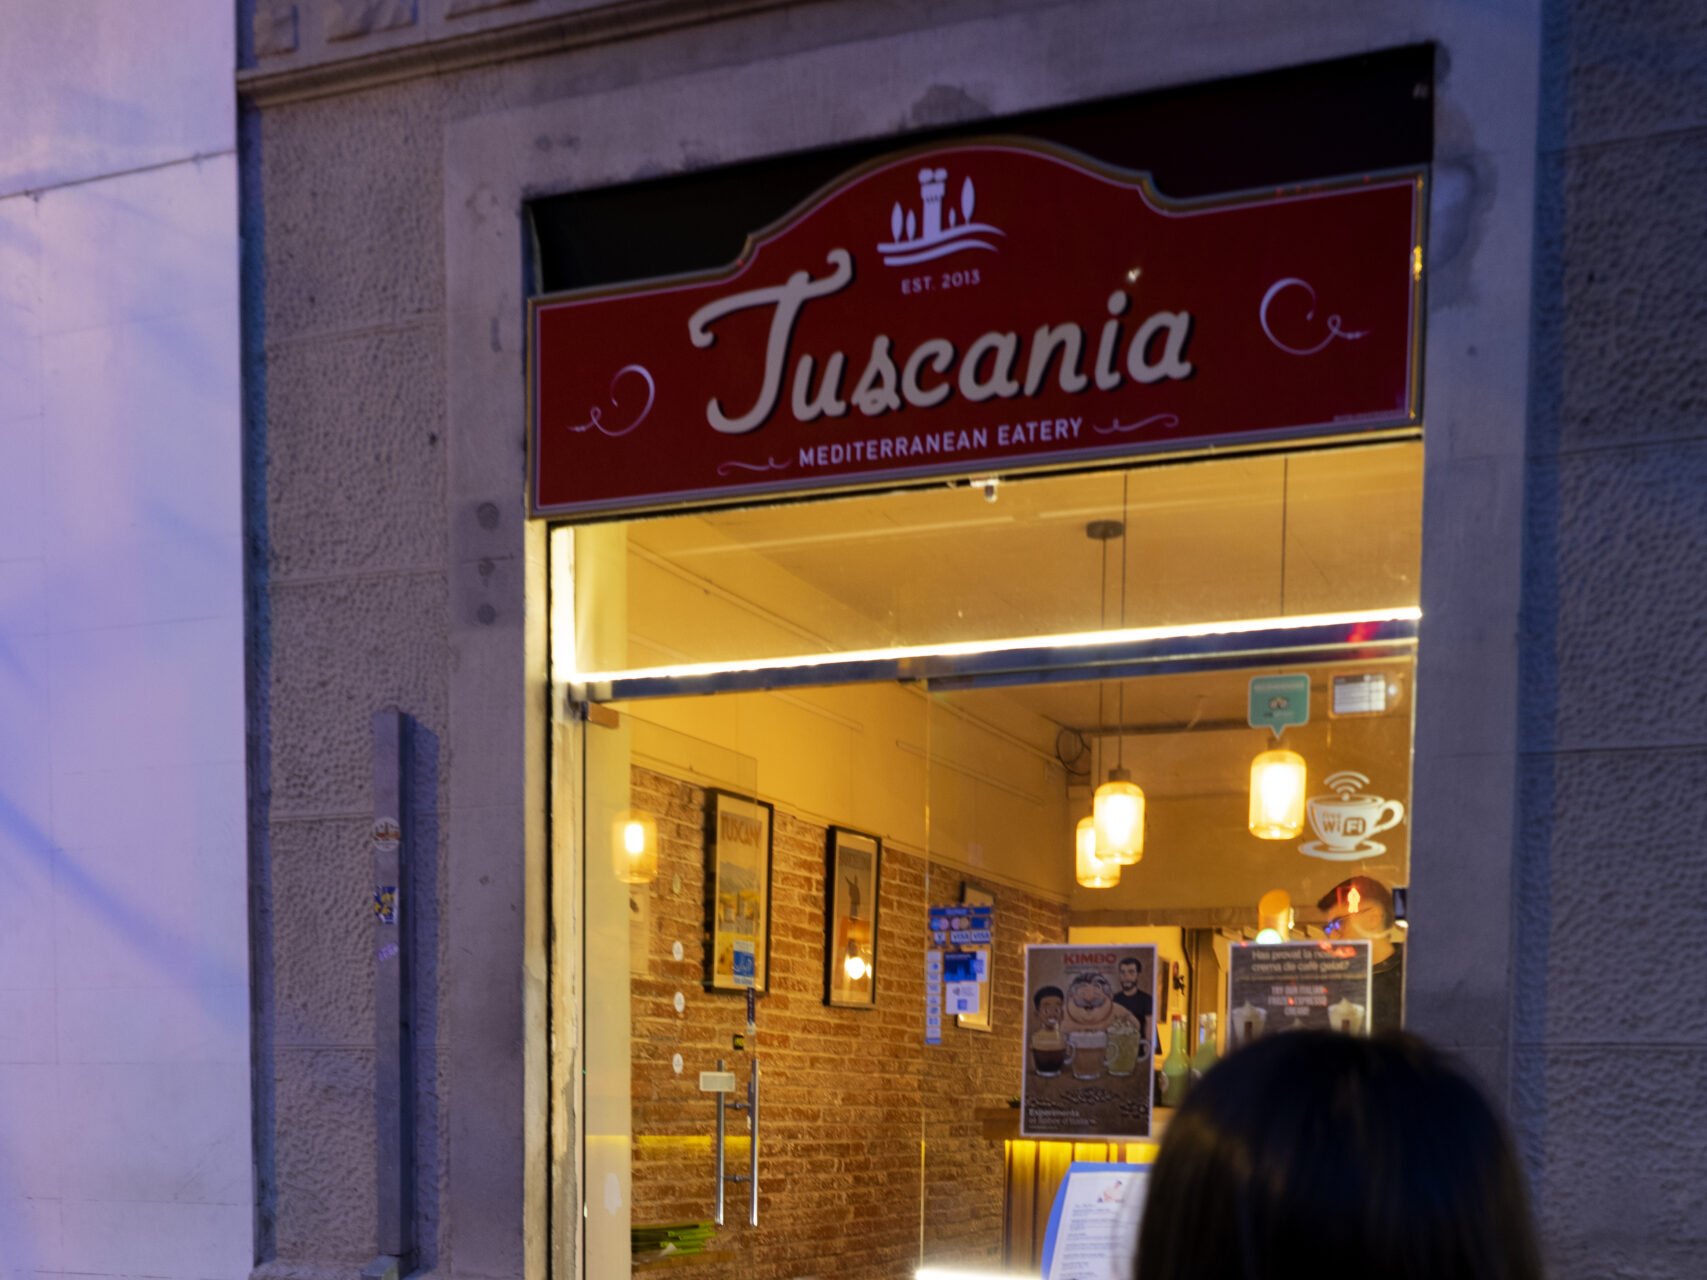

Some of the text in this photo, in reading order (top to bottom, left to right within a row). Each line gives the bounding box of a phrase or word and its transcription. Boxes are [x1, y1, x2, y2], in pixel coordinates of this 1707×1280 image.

[901, 268, 981, 295] EST. 2013
[688, 248, 1193, 434] Tuscania
[798, 416, 1084, 468] MEDITERRANEAN EATERY
[1323, 819, 1364, 833] Wi Fi
[1063, 952, 1118, 965] KIMBO
